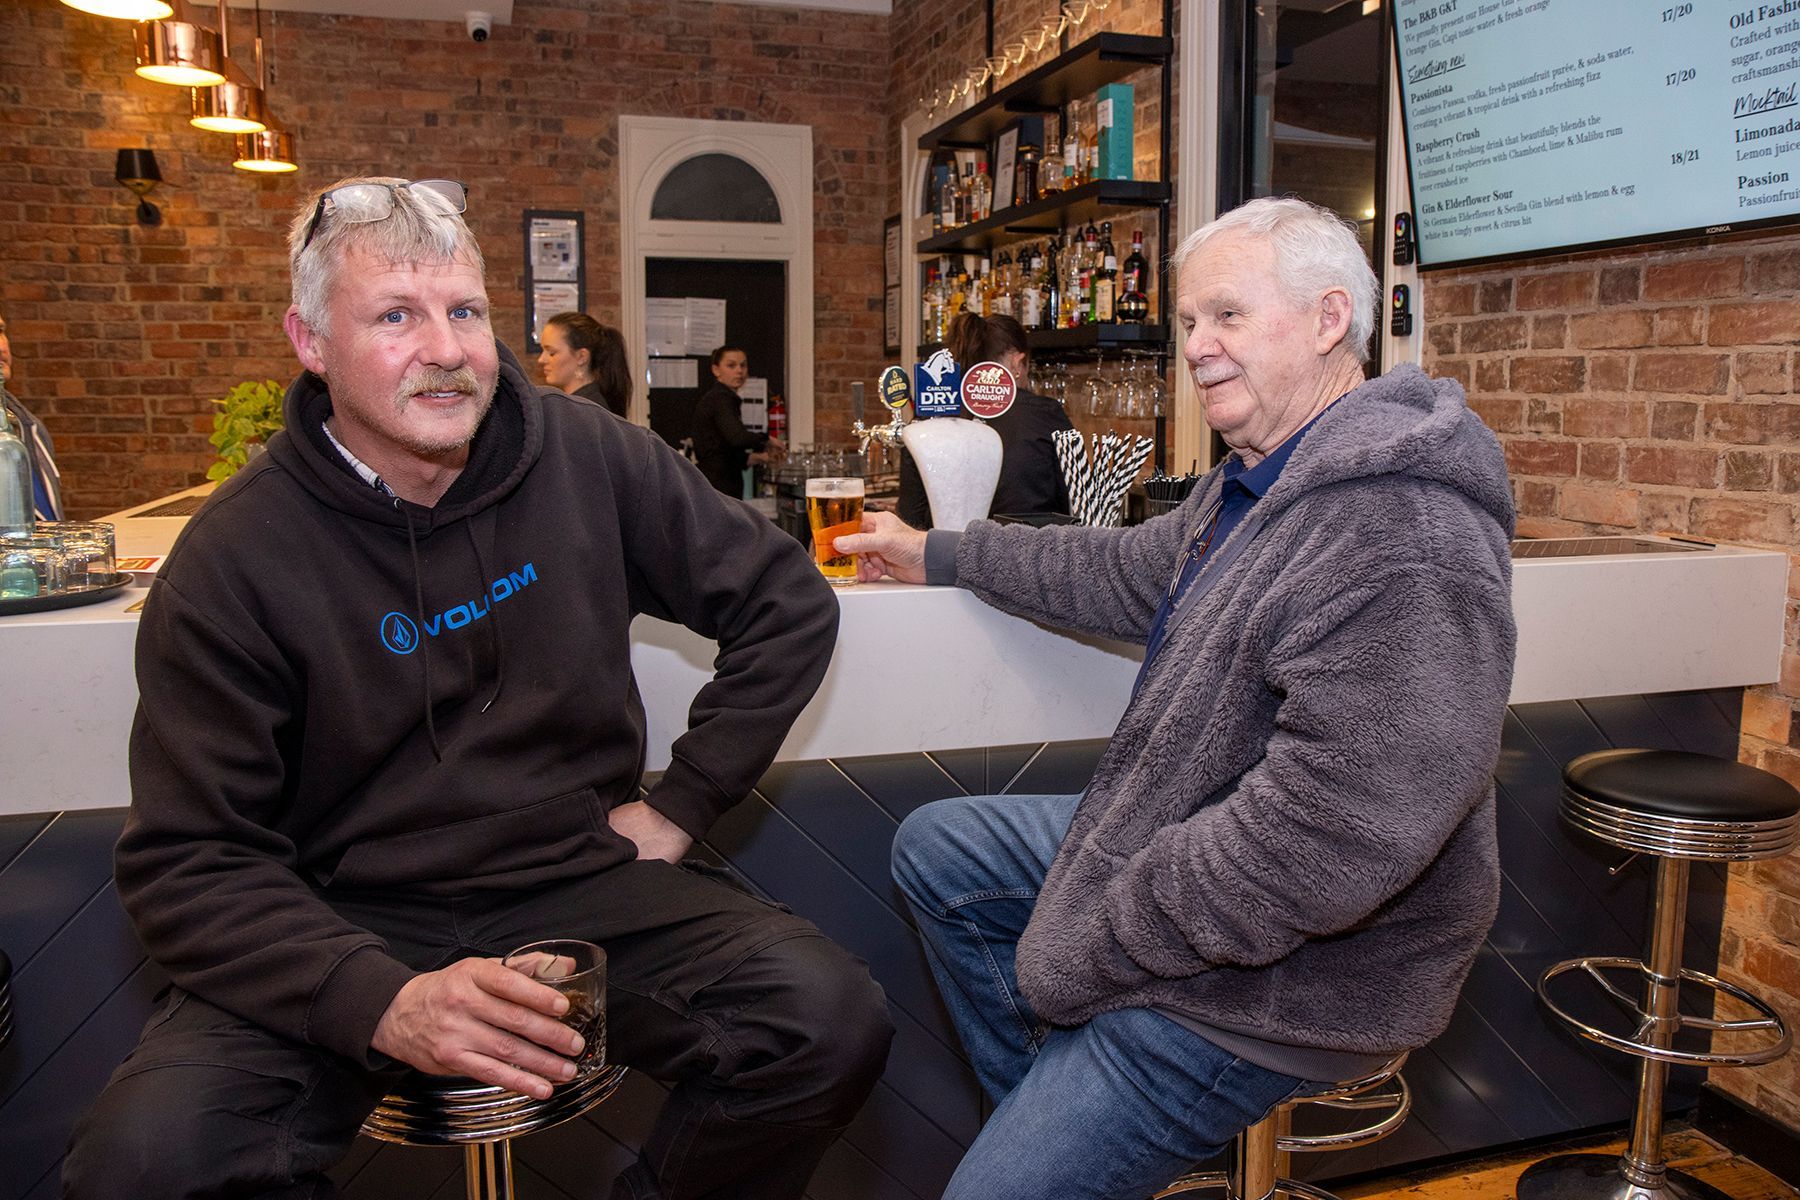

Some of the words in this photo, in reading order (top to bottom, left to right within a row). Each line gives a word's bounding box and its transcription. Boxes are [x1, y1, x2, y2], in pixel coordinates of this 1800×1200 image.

[1404, 17, 1417, 30] The
[1419, 8, 1437, 23] B&B
[1439, 0, 1457, 15] G&T
[1404, 33, 1415, 43] We
[1416, 24, 1439, 42] proudly
[1440, 16, 1464, 32] present
[1465, 11, 1477, 21] our
[1478, 2, 1500, 16] House
[1476, 18, 1496, 31] water
[1497, 14, 1504, 24] &
[1505, 6, 1523, 21] fresh
[1524, 0, 1551, 14] orange
[1662, 2, 1693, 23] 17/20
[1730, 10, 1754, 29] Old
[1730, 26, 1772, 49] Crafted
[1774, 19, 1800, 35] with
[1731, 49, 1763, 67] sugar,
[1488, 82, 1507, 96] fresh
[1508, 70, 1550, 93] passionfruit
[1578, 58, 1585, 69] &
[1587, 53, 1606, 67] soda
[1607, 46, 1635, 60] water,
[1665, 68, 1696, 87] 17/20
[1410, 84, 1453, 104] Passionista
[1467, 106, 1474, 116] &
[1474, 98, 1500, 115] tropical
[1501, 92, 1520, 106] drink
[1521, 88, 1538, 100] with
[1545, 76, 1585, 94] refreshing
[1586, 71, 1601, 83] fizz
[1733, 82, 1798, 115] Mocktail
[1415, 136, 1454, 153] Raspberry
[1455, 127, 1480, 143] Crush
[1445, 151, 1452, 161] &
[1452, 144, 1485, 158] refreshing
[1486, 138, 1504, 150] drink
[1504, 135, 1519, 146] that
[1520, 124, 1559, 142] beautifully
[1560, 118, 1586, 133] blends
[1588, 114, 1601, 126] the
[1455, 157, 1491, 172] raspberries
[1492, 151, 1508, 163] with
[1508, 142, 1547, 160] Chambord,
[1549, 140, 1566, 152] lime
[1567, 136, 1574, 146] &
[1576, 130, 1604, 145] Malibu
[1606, 127, 1623, 137] rum
[1671, 148, 1700, 165] 18/21
[1736, 146, 1772, 162] Lemon
[1420, 182, 1433, 192] over
[1433, 176, 1458, 190] crushed
[1459, 176, 1469, 185] ice
[1738, 171, 1789, 189] Passion
[1422, 203, 1436, 215] Gin
[1437, 201, 1444, 212] &
[1445, 194, 1491, 211] Elderflower
[1492, 190, 1514, 201] Sour
[1423, 219, 1430, 228] St
[1431, 215, 1457, 227] Germain
[1458, 209, 1496, 222] Elderflower
[1497, 205, 1503, 215] &
[1504, 202, 1527, 213] Sevilla
[1529, 200, 1542, 210] Gin
[1544, 194, 1564, 207] blend
[1566, 191, 1583, 203] with
[1584, 189, 1609, 201] lemon
[1611, 184, 1618, 195] &
[1620, 184, 1635, 196] egg
[1739, 188, 1800, 208] Passionfrui
[1473, 223, 1492, 233] sweet
[1494, 220, 1500, 230] &
[1500, 218, 1521, 229] citrus
[1706, 225, 1731, 235] KONKA
[921, 391, 959, 405] DRY
[965, 384, 1010, 396] CARLTON
[971, 393, 1005, 401] DRAUGHT
[423, 562, 538, 637] VOLOM
